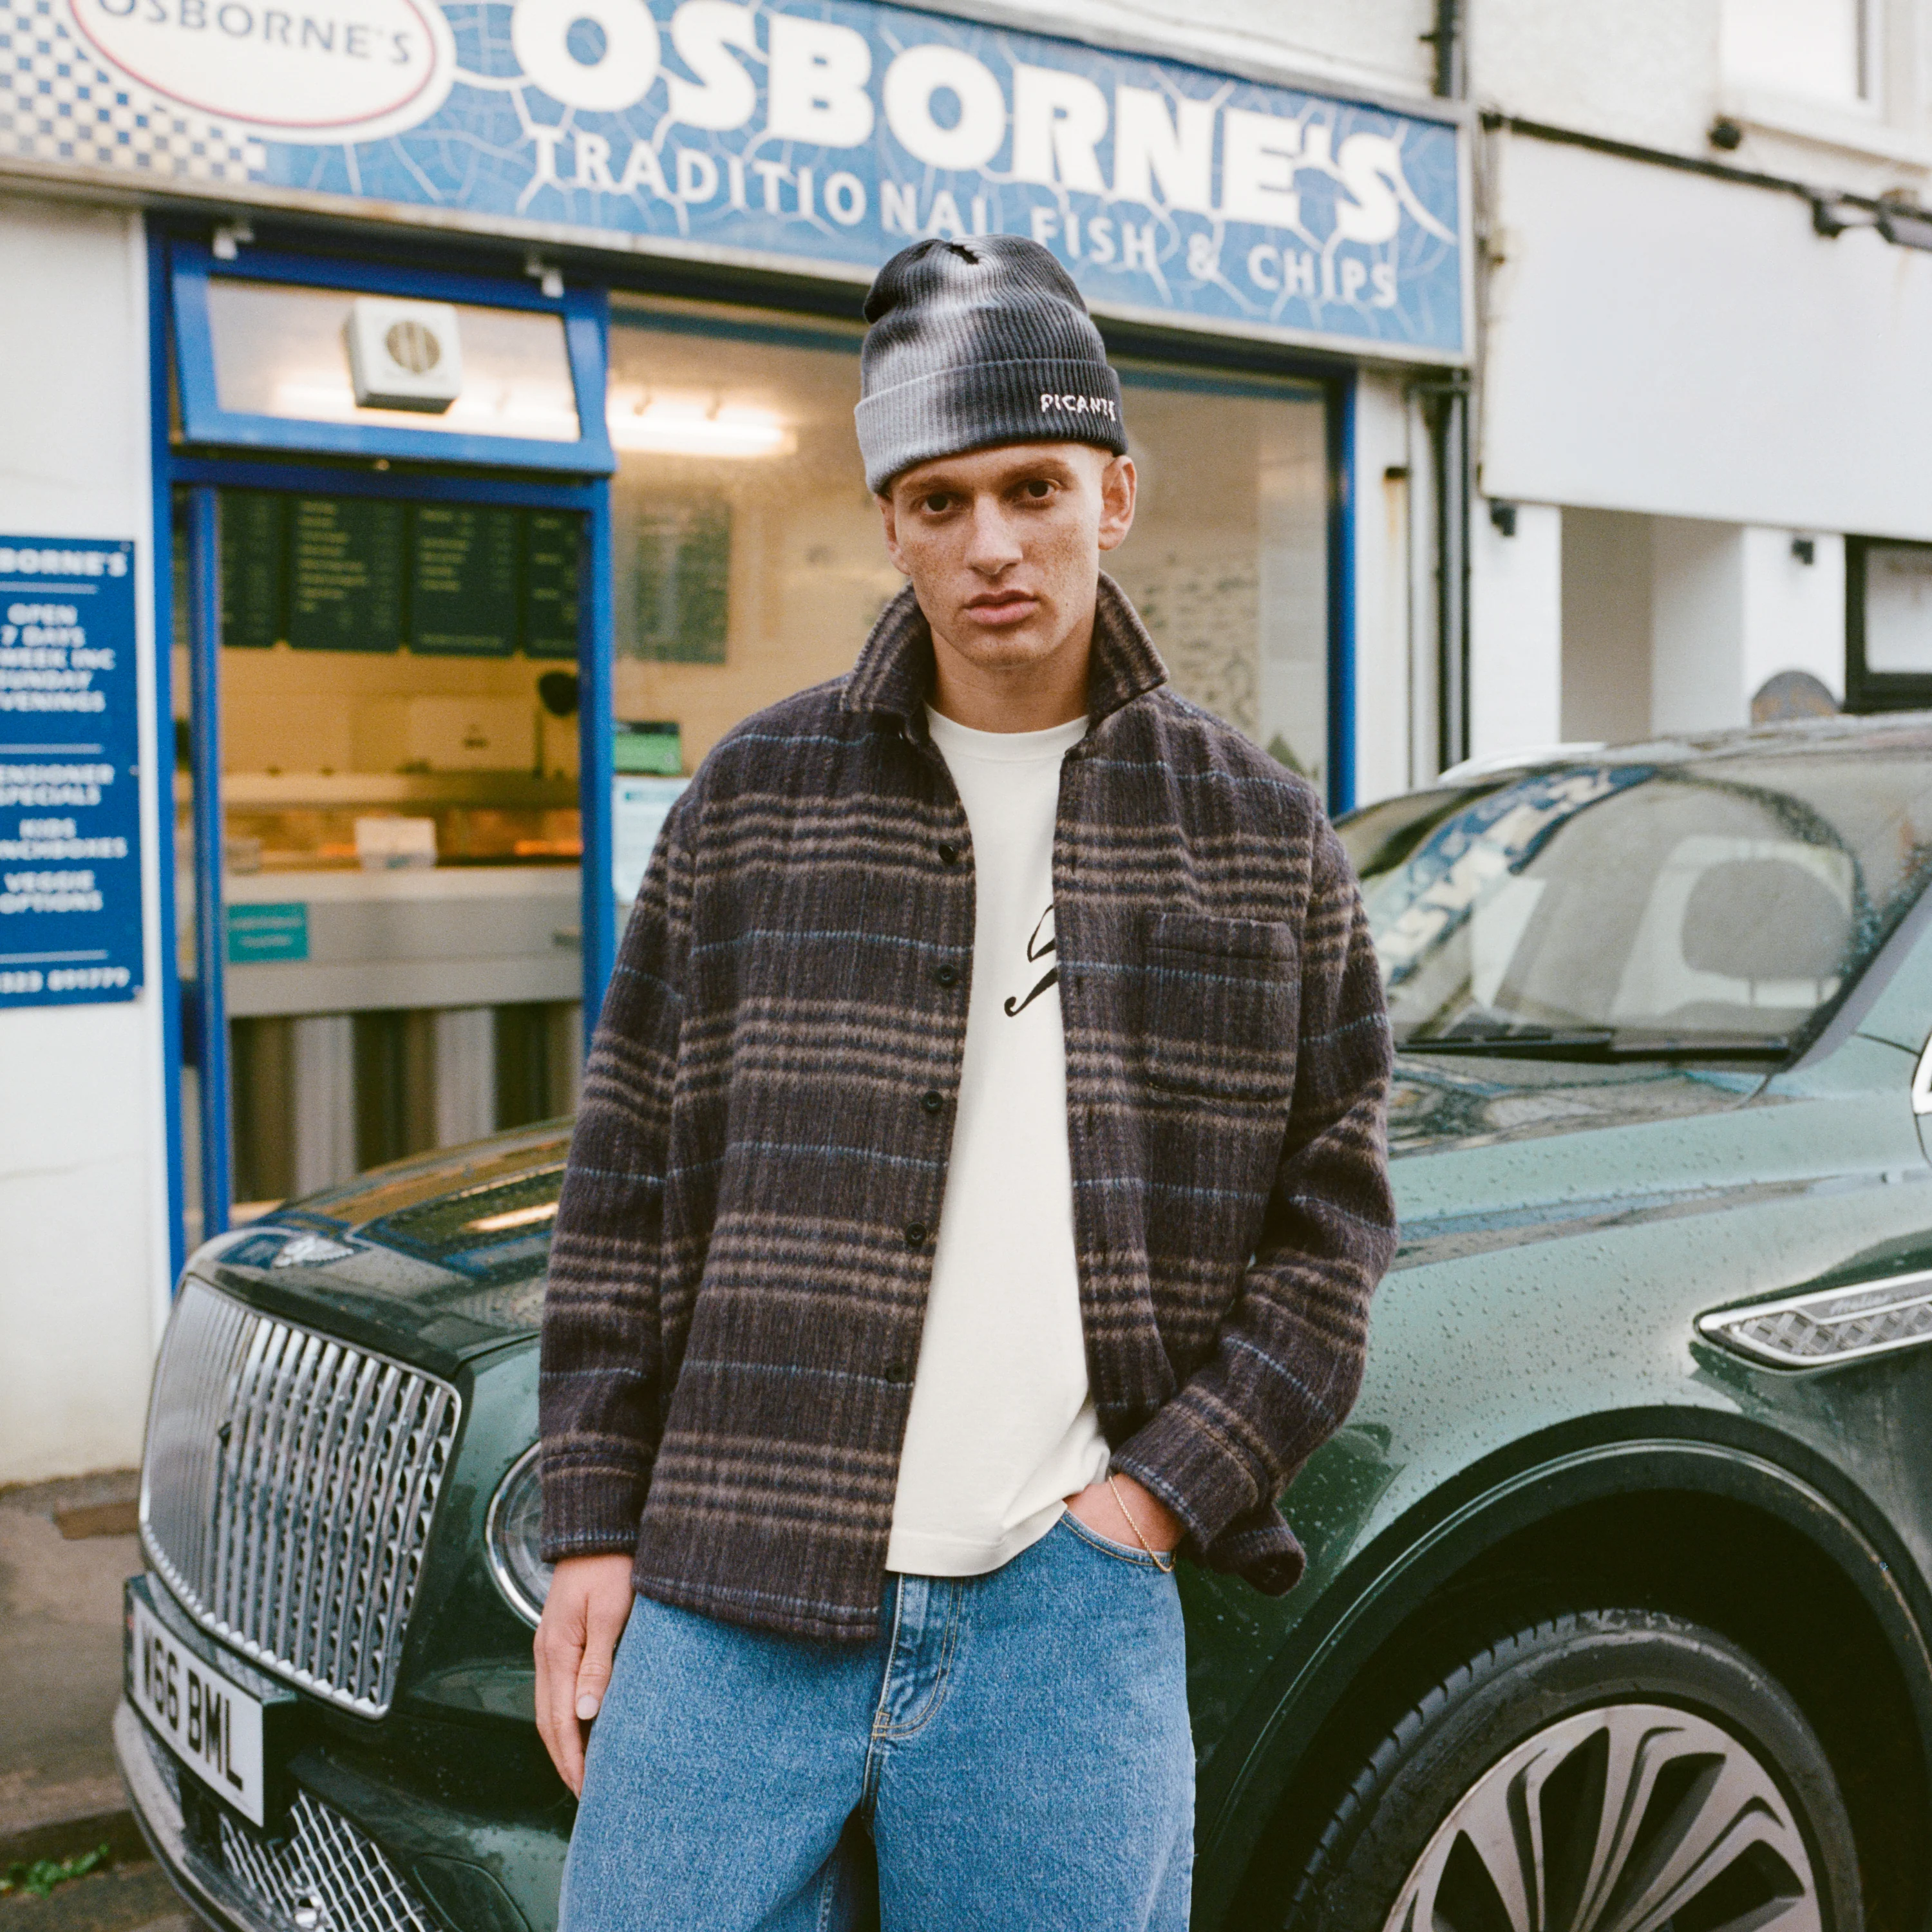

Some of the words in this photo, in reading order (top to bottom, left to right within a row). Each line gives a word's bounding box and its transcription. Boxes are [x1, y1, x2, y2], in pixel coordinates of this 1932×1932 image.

[511, 0, 1401, 245] OSBORNE'S
[1032, 206, 1157, 269] FISH
[1188, 233, 1219, 280] &
[1247, 245, 1397, 308] CHIPS
[8, 603, 77, 625] OPEN
[187, 1668, 244, 1792] BML
